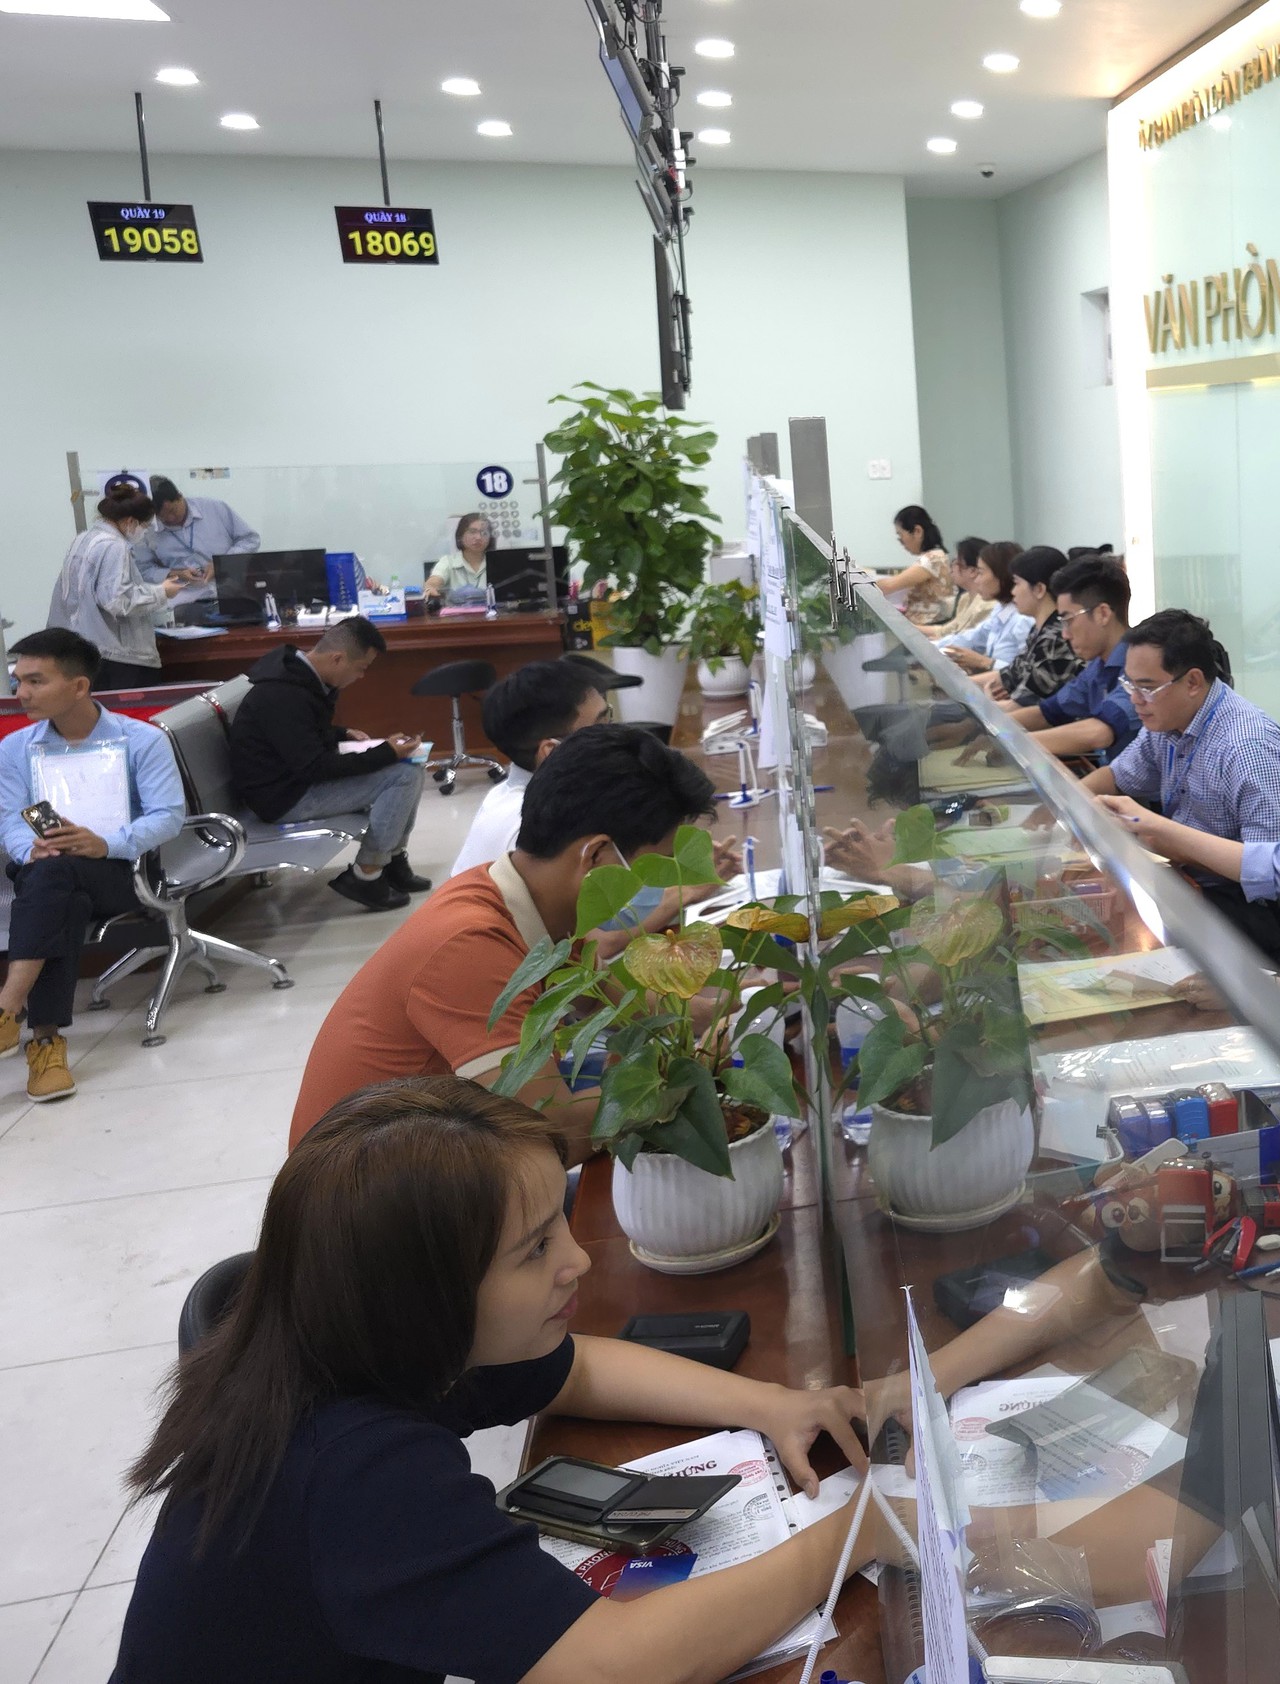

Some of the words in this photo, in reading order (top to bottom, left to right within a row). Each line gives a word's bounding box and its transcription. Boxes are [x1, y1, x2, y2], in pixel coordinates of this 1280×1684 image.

[152, 208, 165, 220] 19
[104, 227, 199, 255] 19058
[348, 230, 436, 257] 18069
[1143, 273, 1198, 354] VĂN
[481, 471, 508, 493] 18
[629, 1561, 654, 1569] VISA
